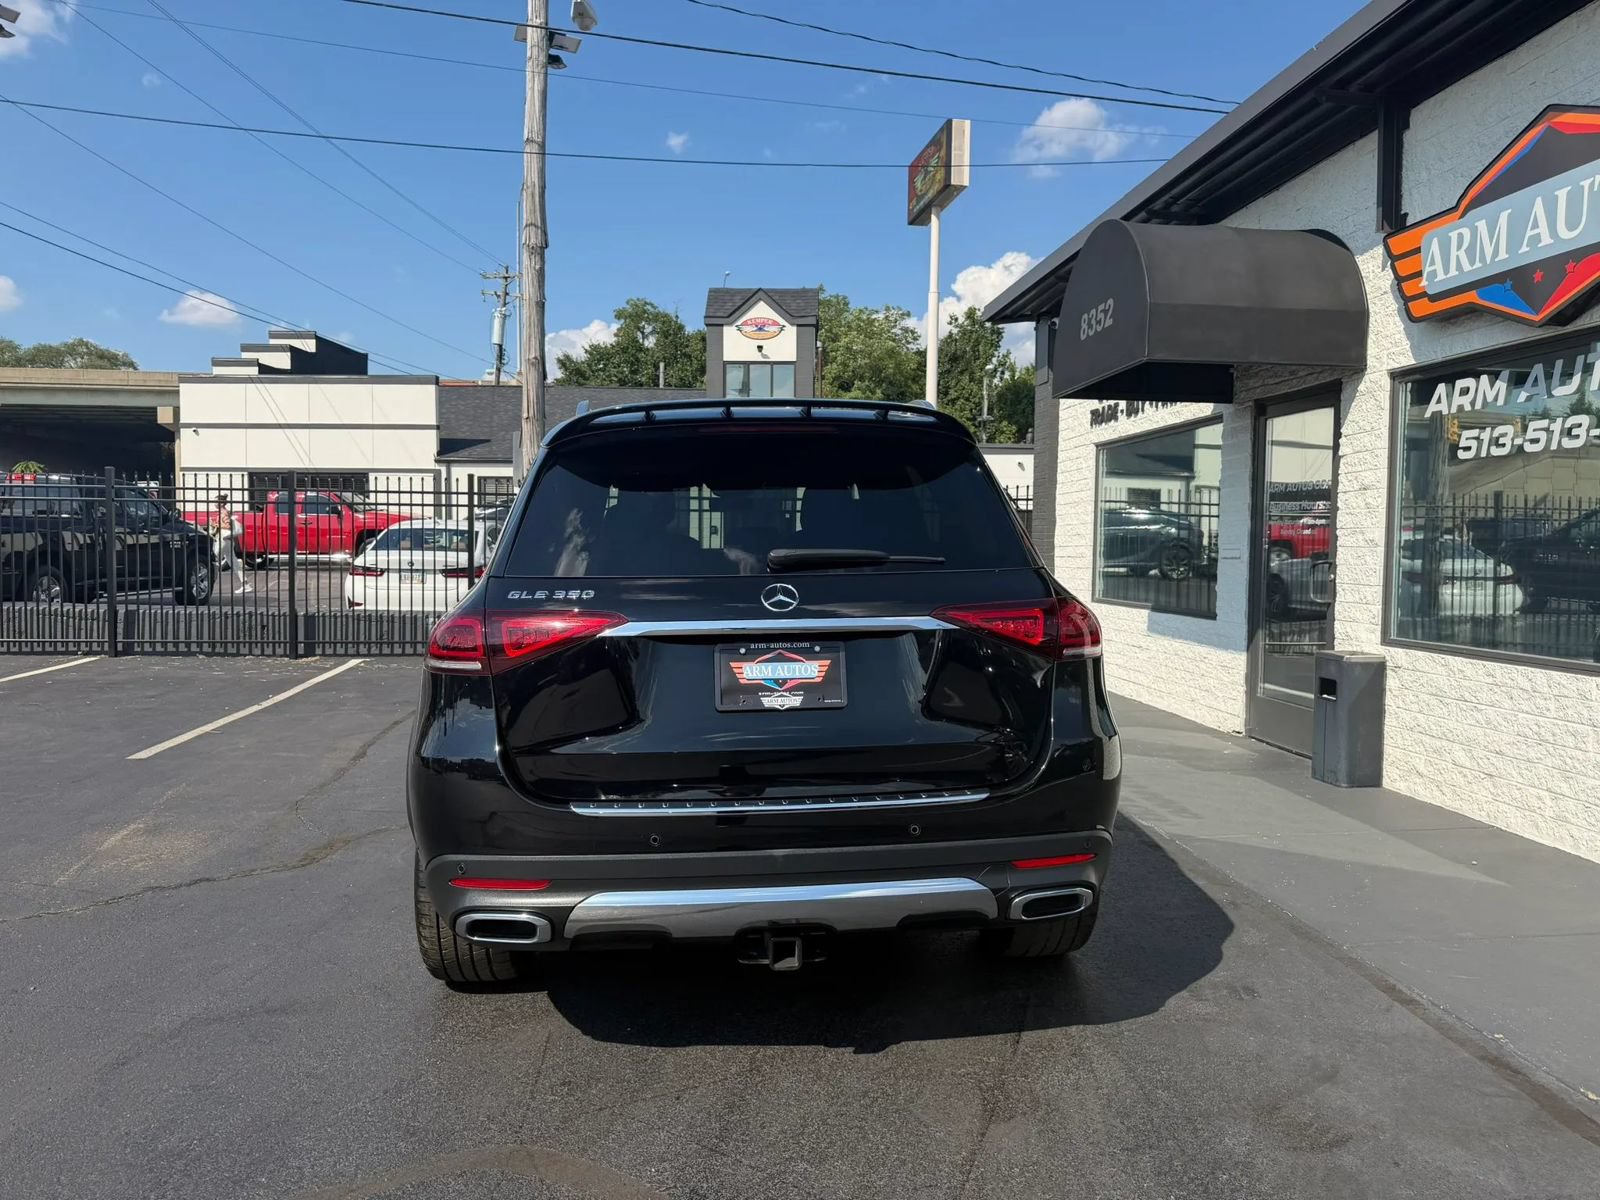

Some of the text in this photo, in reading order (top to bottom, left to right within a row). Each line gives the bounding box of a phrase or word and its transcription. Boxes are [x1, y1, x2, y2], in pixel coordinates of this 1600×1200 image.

[1419, 174, 1600, 287] ARM AU
[1080, 298, 1114, 341] 8352
[1424, 369, 1510, 418] ARM
[507, 590, 595, 599] GLE 350
[744, 663, 818, 677] ARM AUTOS
